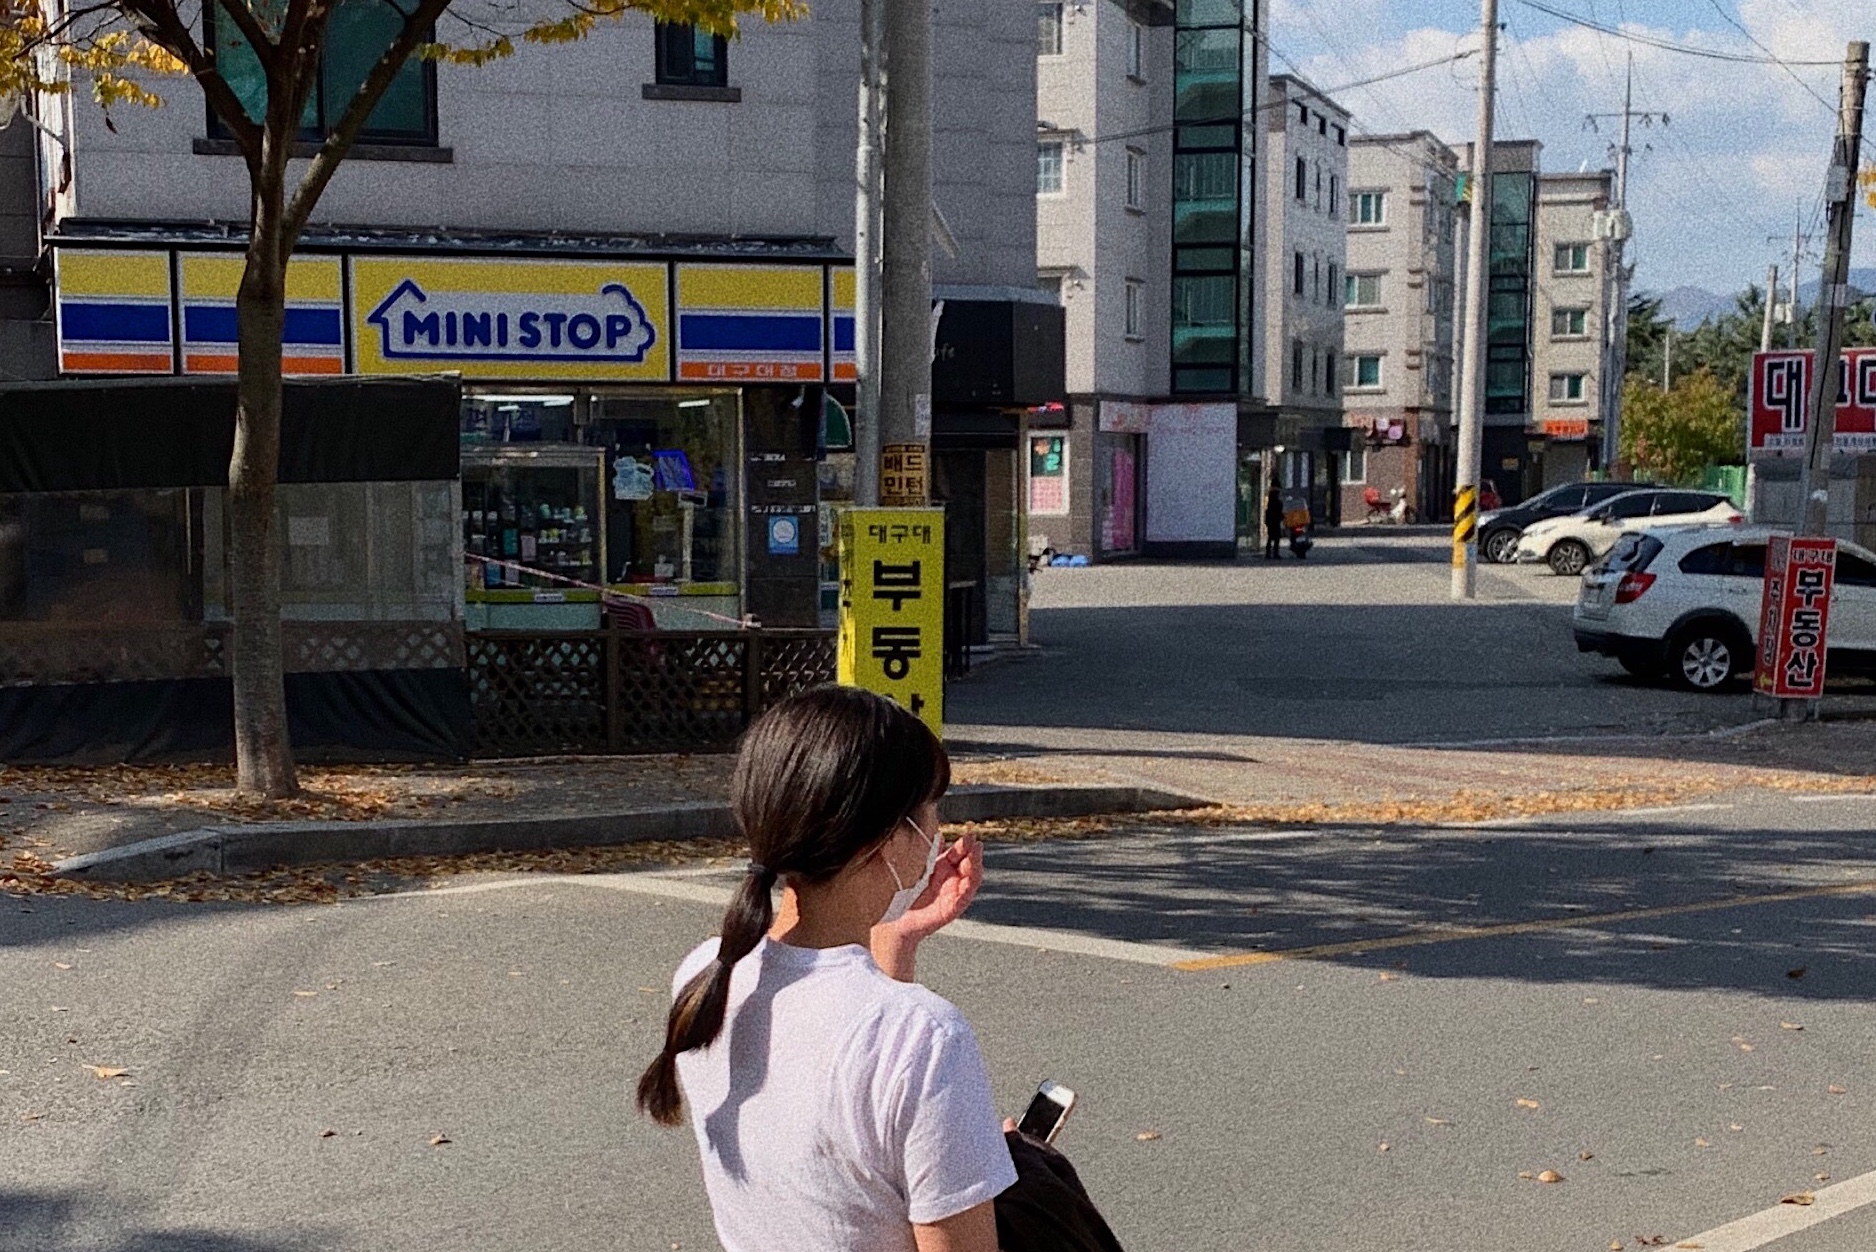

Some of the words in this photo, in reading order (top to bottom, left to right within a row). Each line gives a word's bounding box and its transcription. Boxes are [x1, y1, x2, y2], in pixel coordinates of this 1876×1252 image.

[707, 363, 797, 377] 대구대점
[884, 454, 923, 472] 배드
[884, 476, 923, 495] 민턴
[868, 524, 931, 544] 대구대
[1792, 548, 1834, 564] 대구대
[1785, 568, 1825, 688] 부동산
